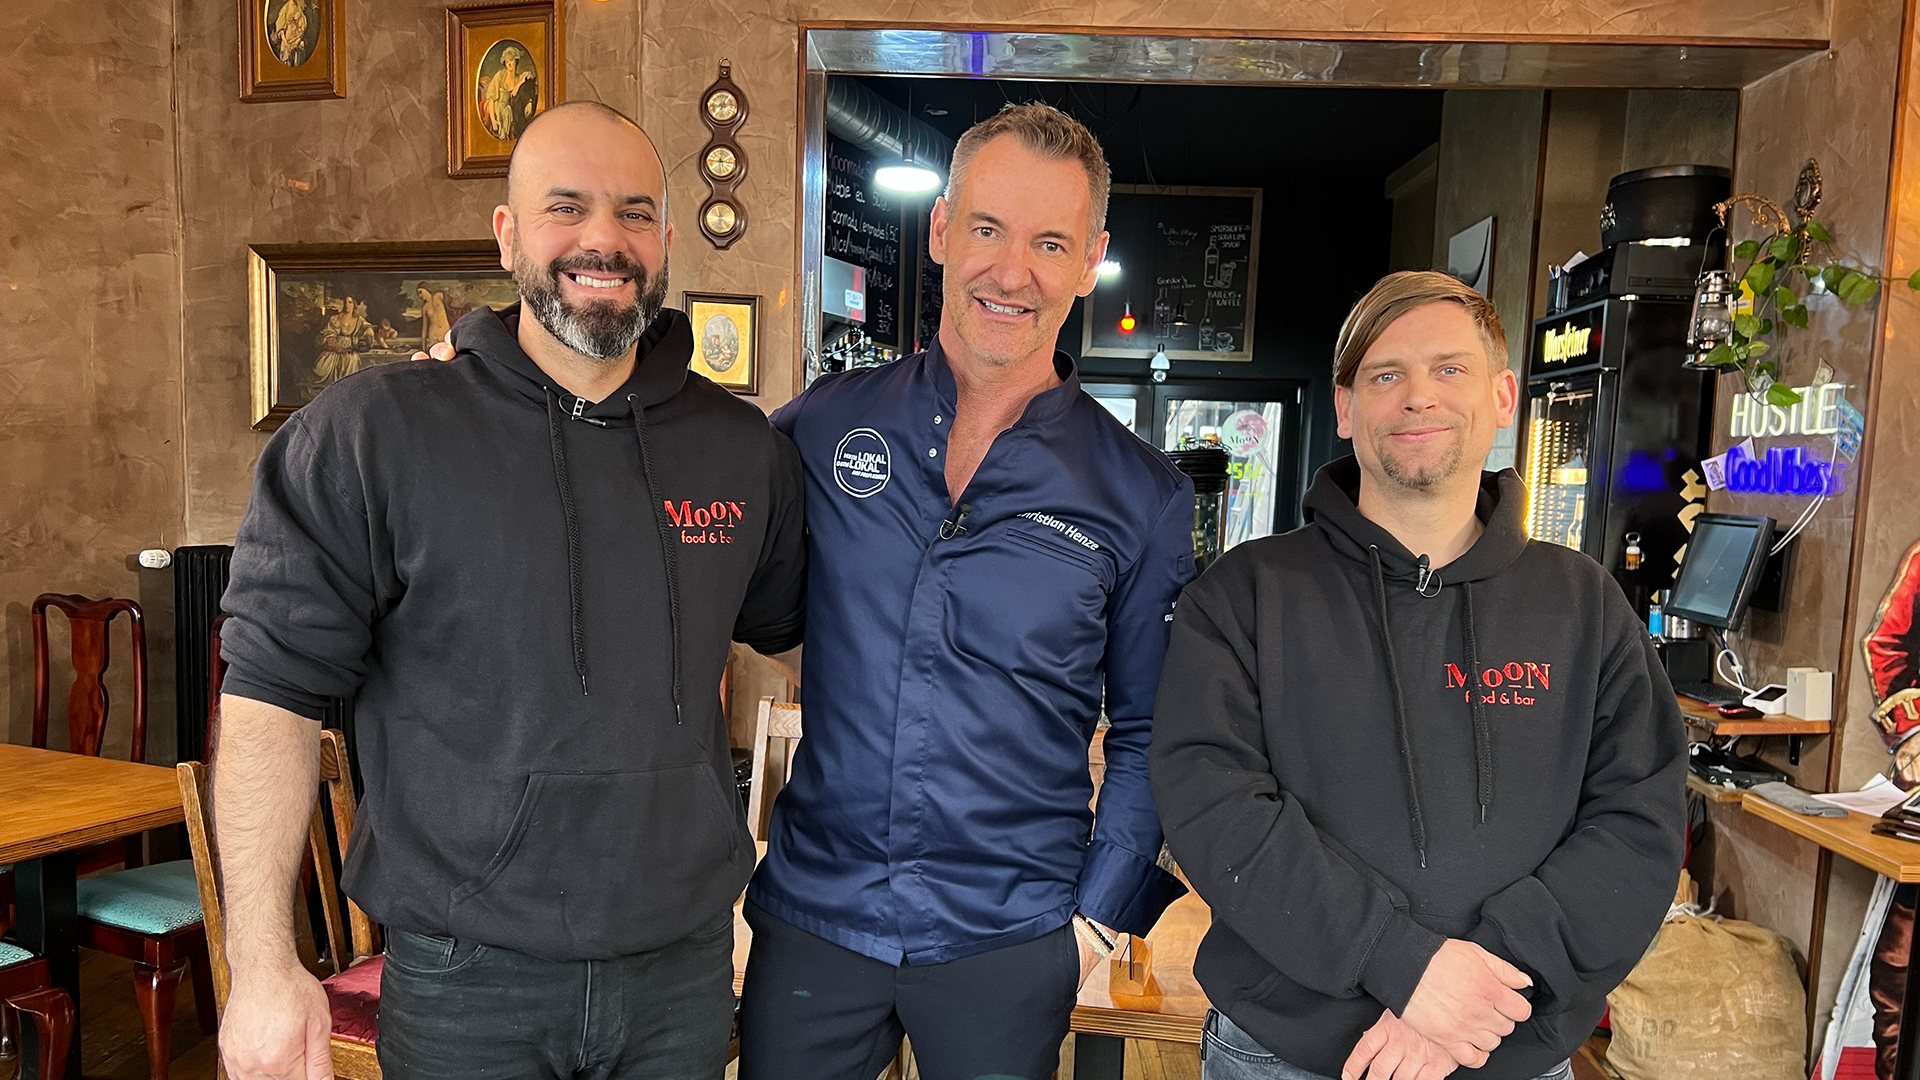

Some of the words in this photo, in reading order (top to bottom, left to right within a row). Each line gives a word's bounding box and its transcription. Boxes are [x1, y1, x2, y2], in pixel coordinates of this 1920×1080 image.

[1730, 383, 1841, 437] HUSTLE
[858, 452, 887, 464] LOKAL
[849, 460, 880, 473] LOKAL
[681, 529, 706, 544] food
[708, 532, 718, 544] &
[1016, 511, 1067, 532] hristian
[1064, 525, 1099, 551] Henze
[1464, 690, 1496, 705] fod
[1499, 692, 1511, 705] &
[1513, 690, 1536, 705] bar
